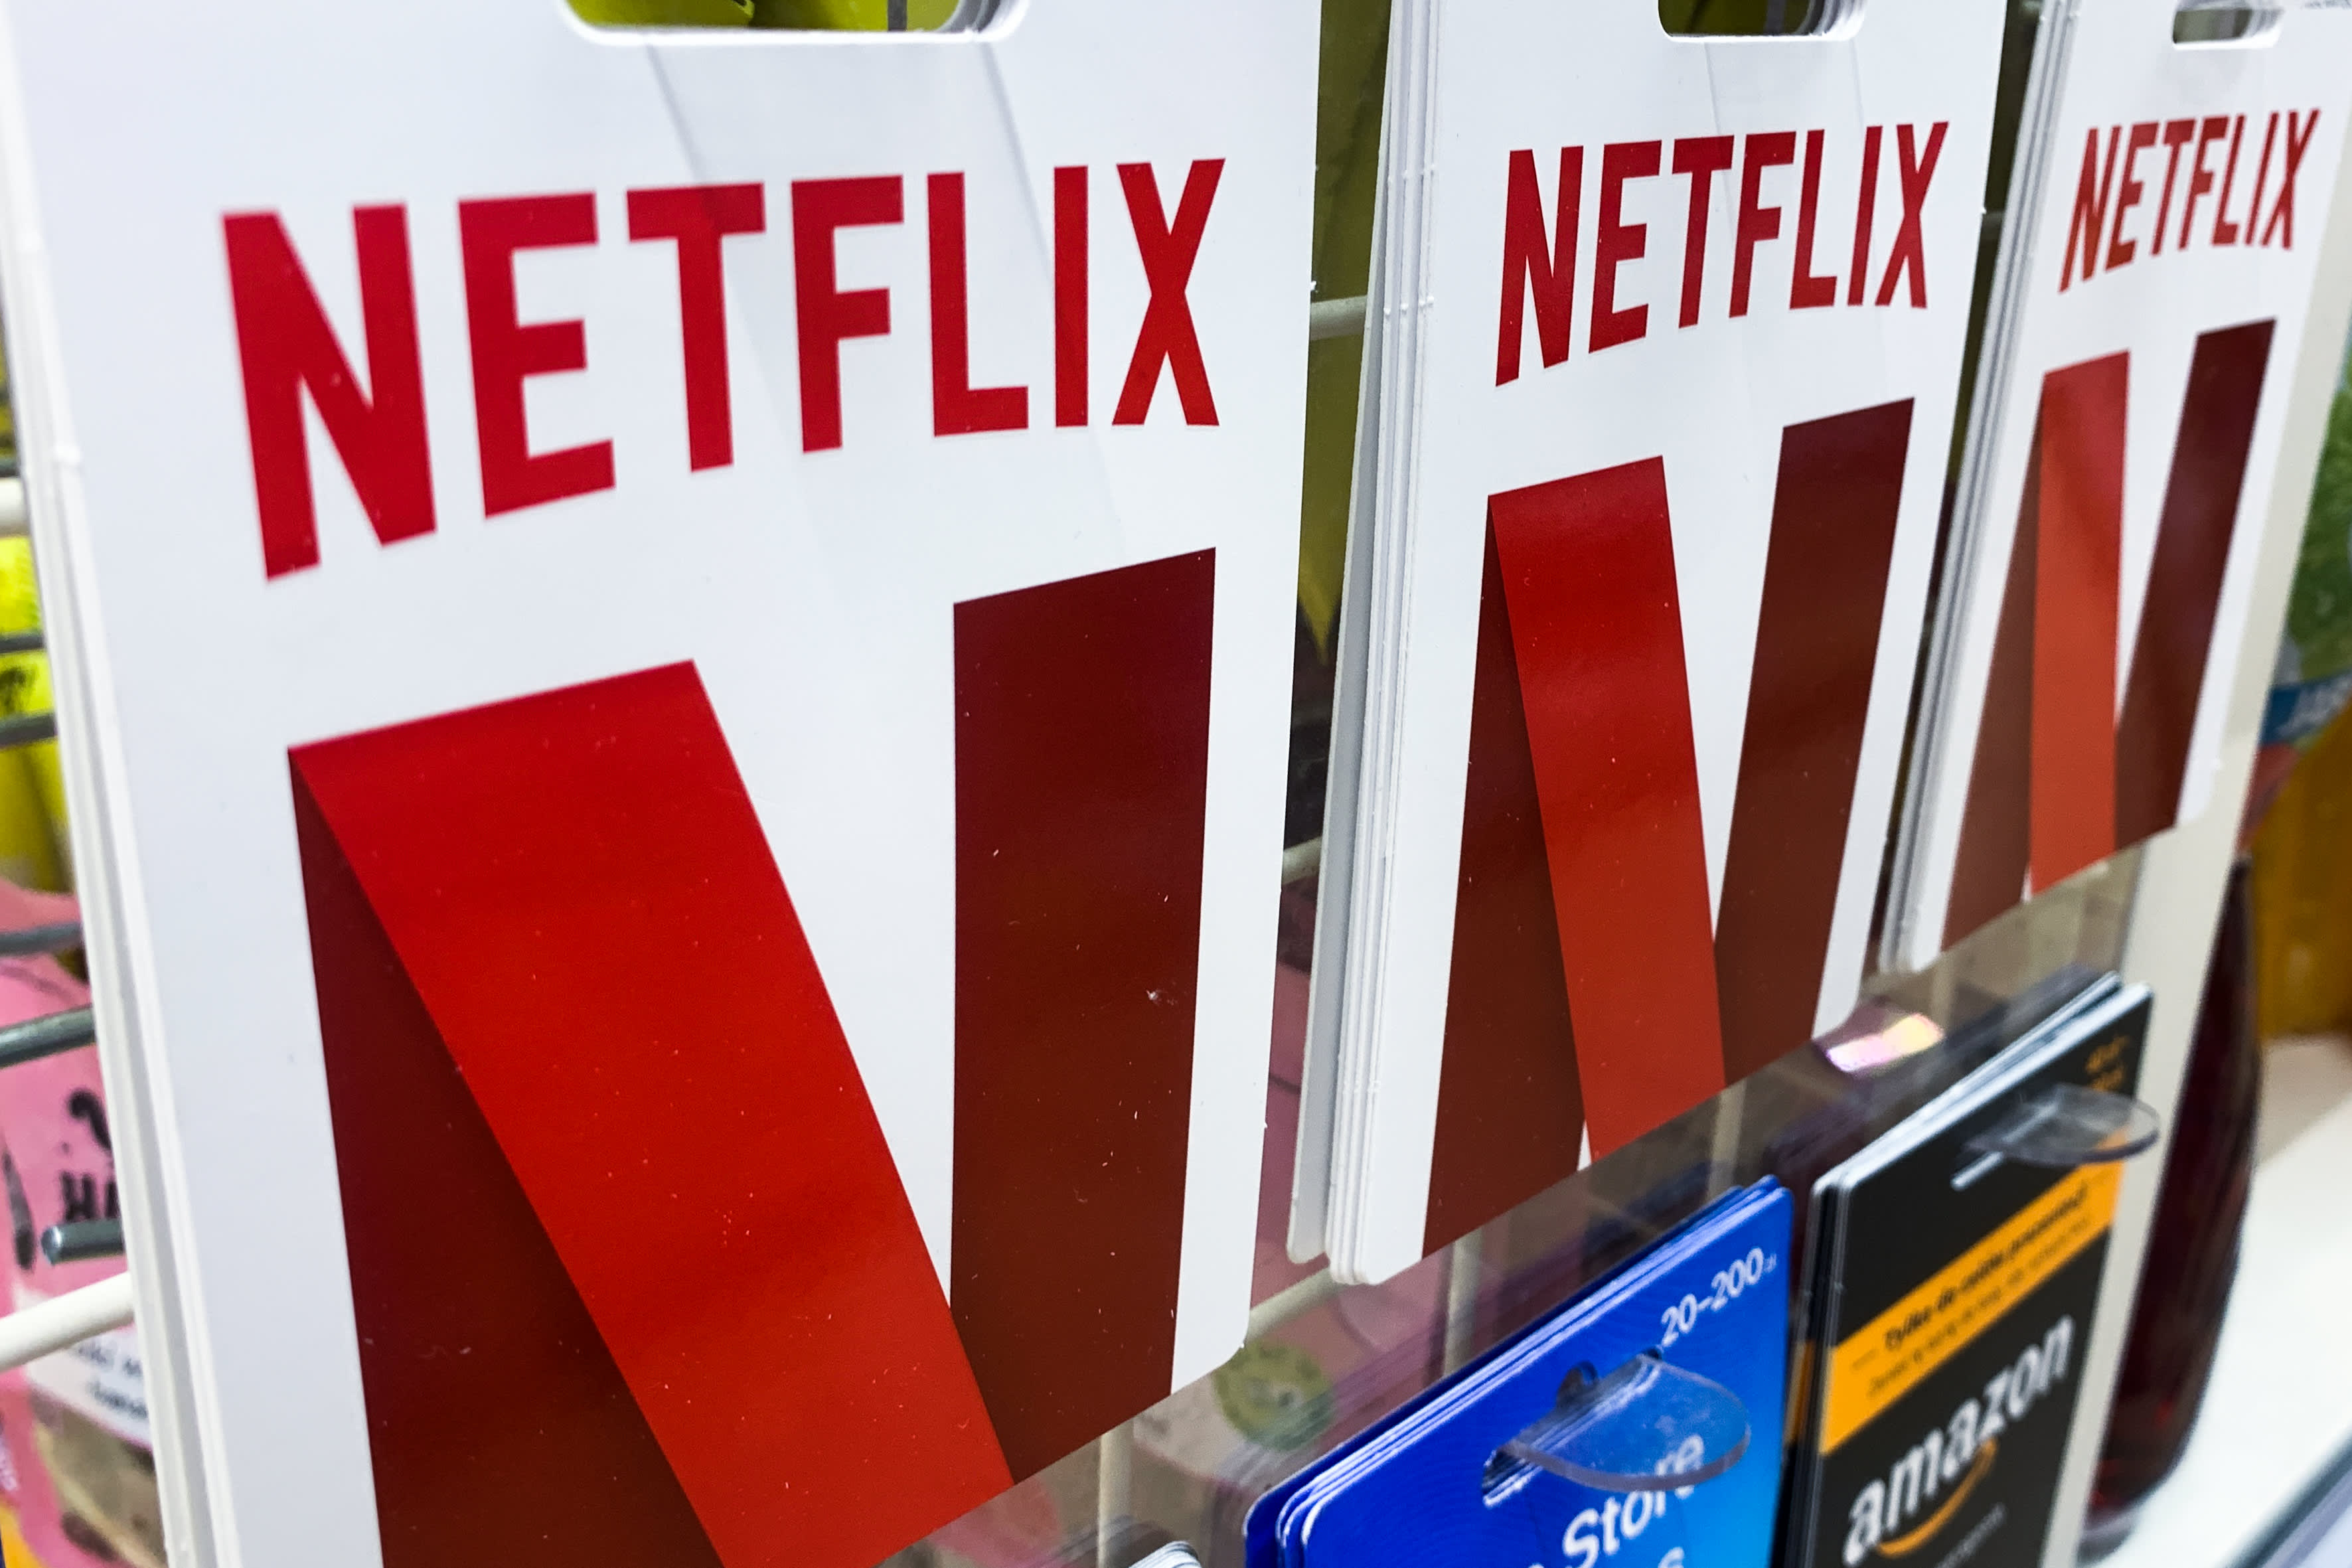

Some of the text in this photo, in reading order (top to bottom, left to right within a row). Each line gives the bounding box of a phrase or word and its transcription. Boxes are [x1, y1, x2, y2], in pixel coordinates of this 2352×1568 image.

[1494, 120, 1950, 387] NETFLIX
[2059, 108, 2321, 293] NETFLIX
[220, 157, 1227, 582] NETFLIX
[1562, 1435, 1703, 1568] Store
[1843, 1315, 2075, 1567] amazon
